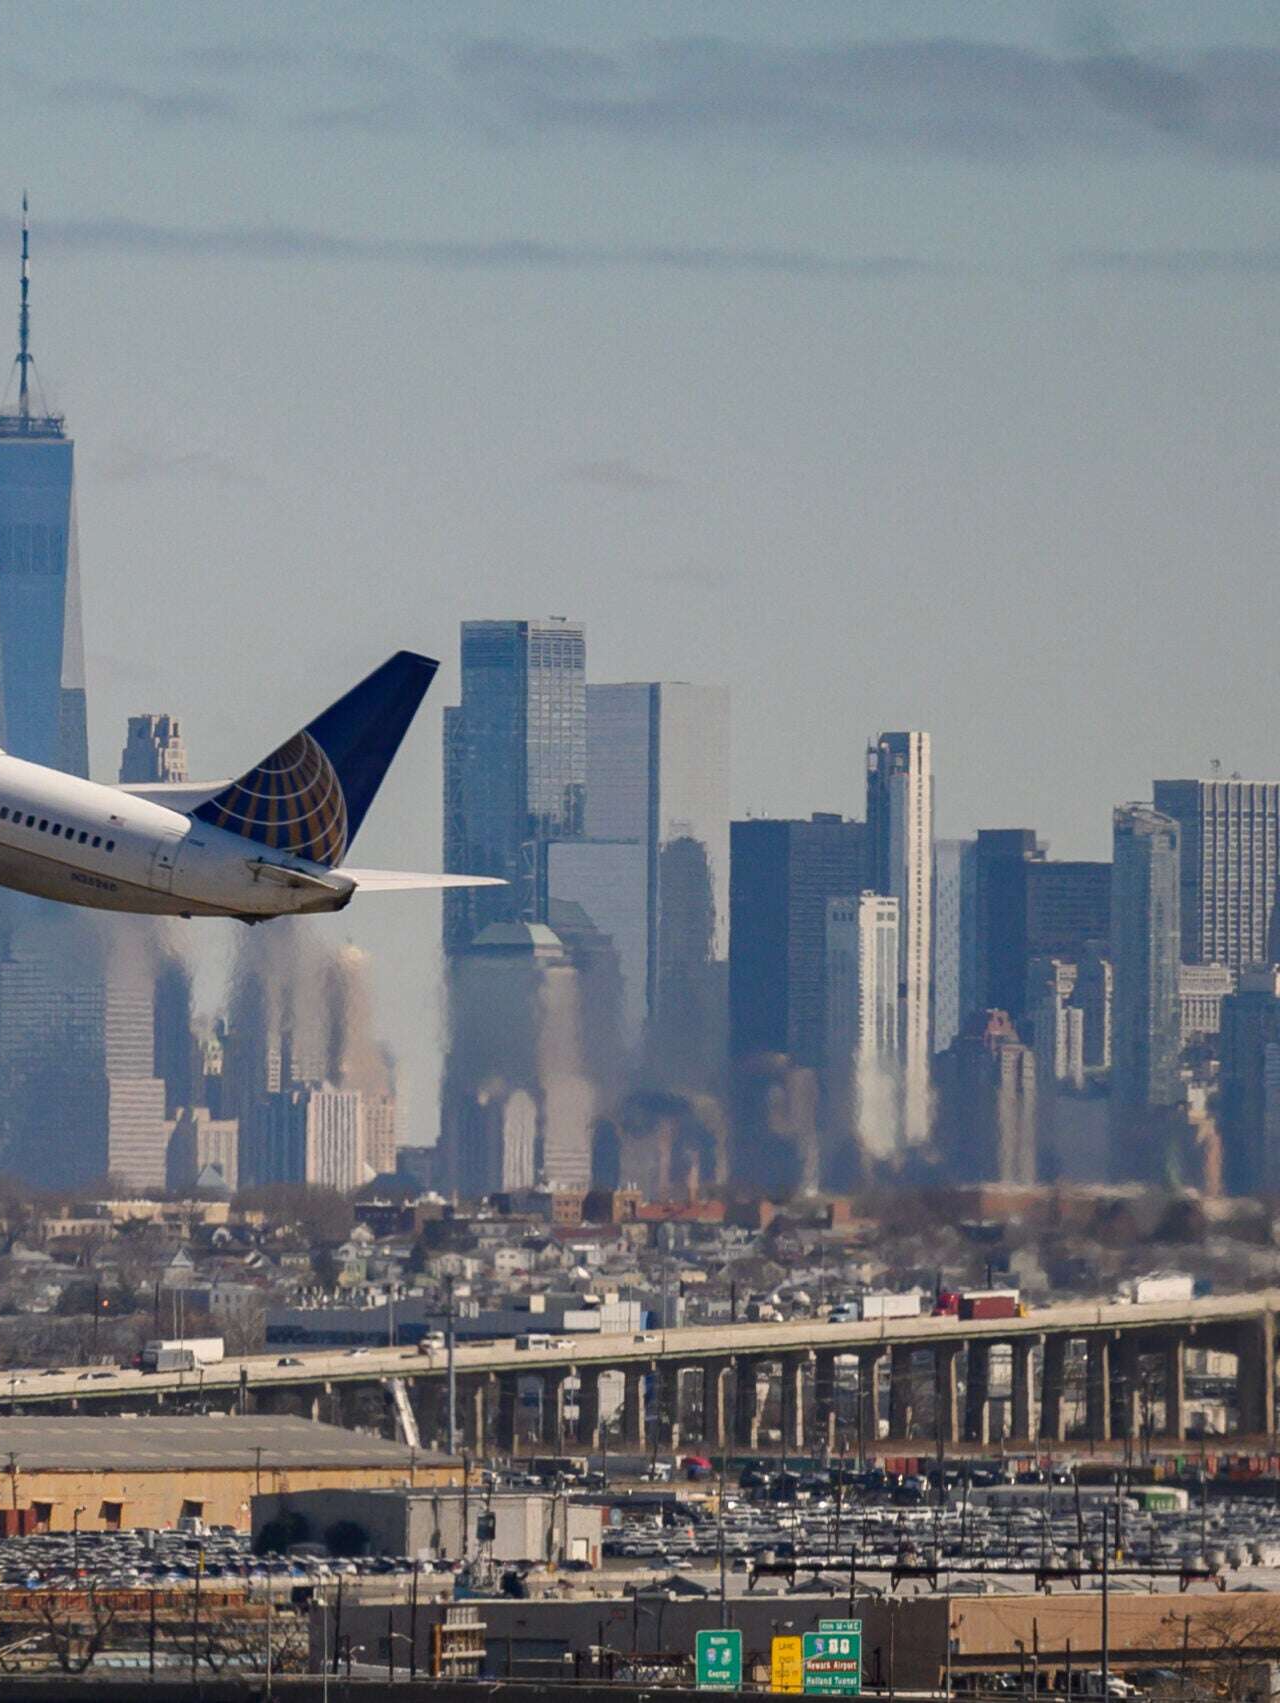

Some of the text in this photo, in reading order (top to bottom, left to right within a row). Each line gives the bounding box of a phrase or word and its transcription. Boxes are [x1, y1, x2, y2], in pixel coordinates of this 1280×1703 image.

[807, 1661, 857, 1671] Newark Airport
[708, 1670, 730, 1680] George
[806, 1676, 857, 1685] Holland Tunnel
